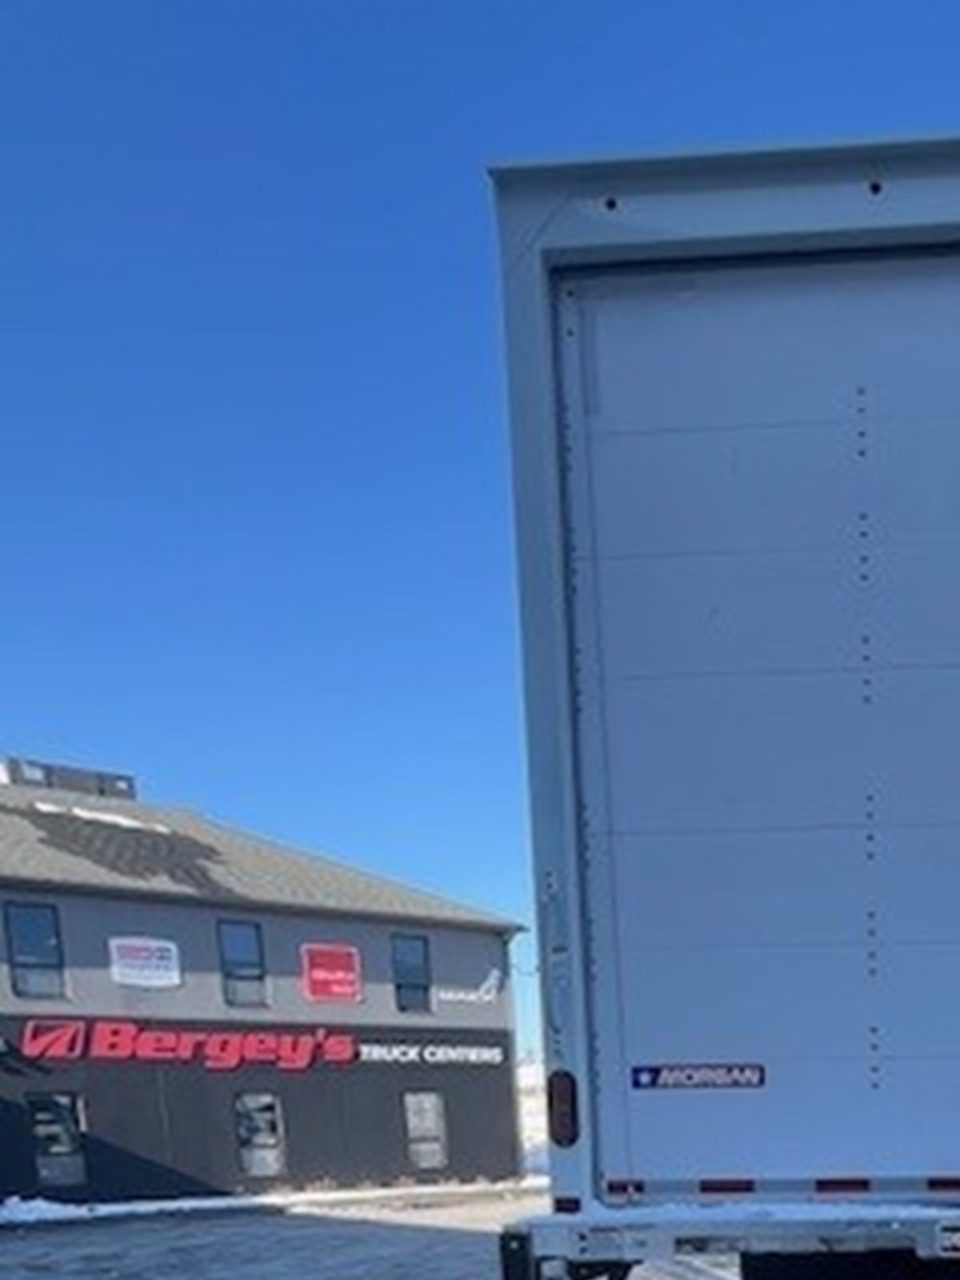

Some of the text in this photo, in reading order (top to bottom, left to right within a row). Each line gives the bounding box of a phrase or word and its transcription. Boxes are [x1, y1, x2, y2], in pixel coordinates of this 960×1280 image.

[92, 1021, 504, 1069] Bergey's TRUCK CENTERS
[657, 1066, 761, 1085] MORGAN
